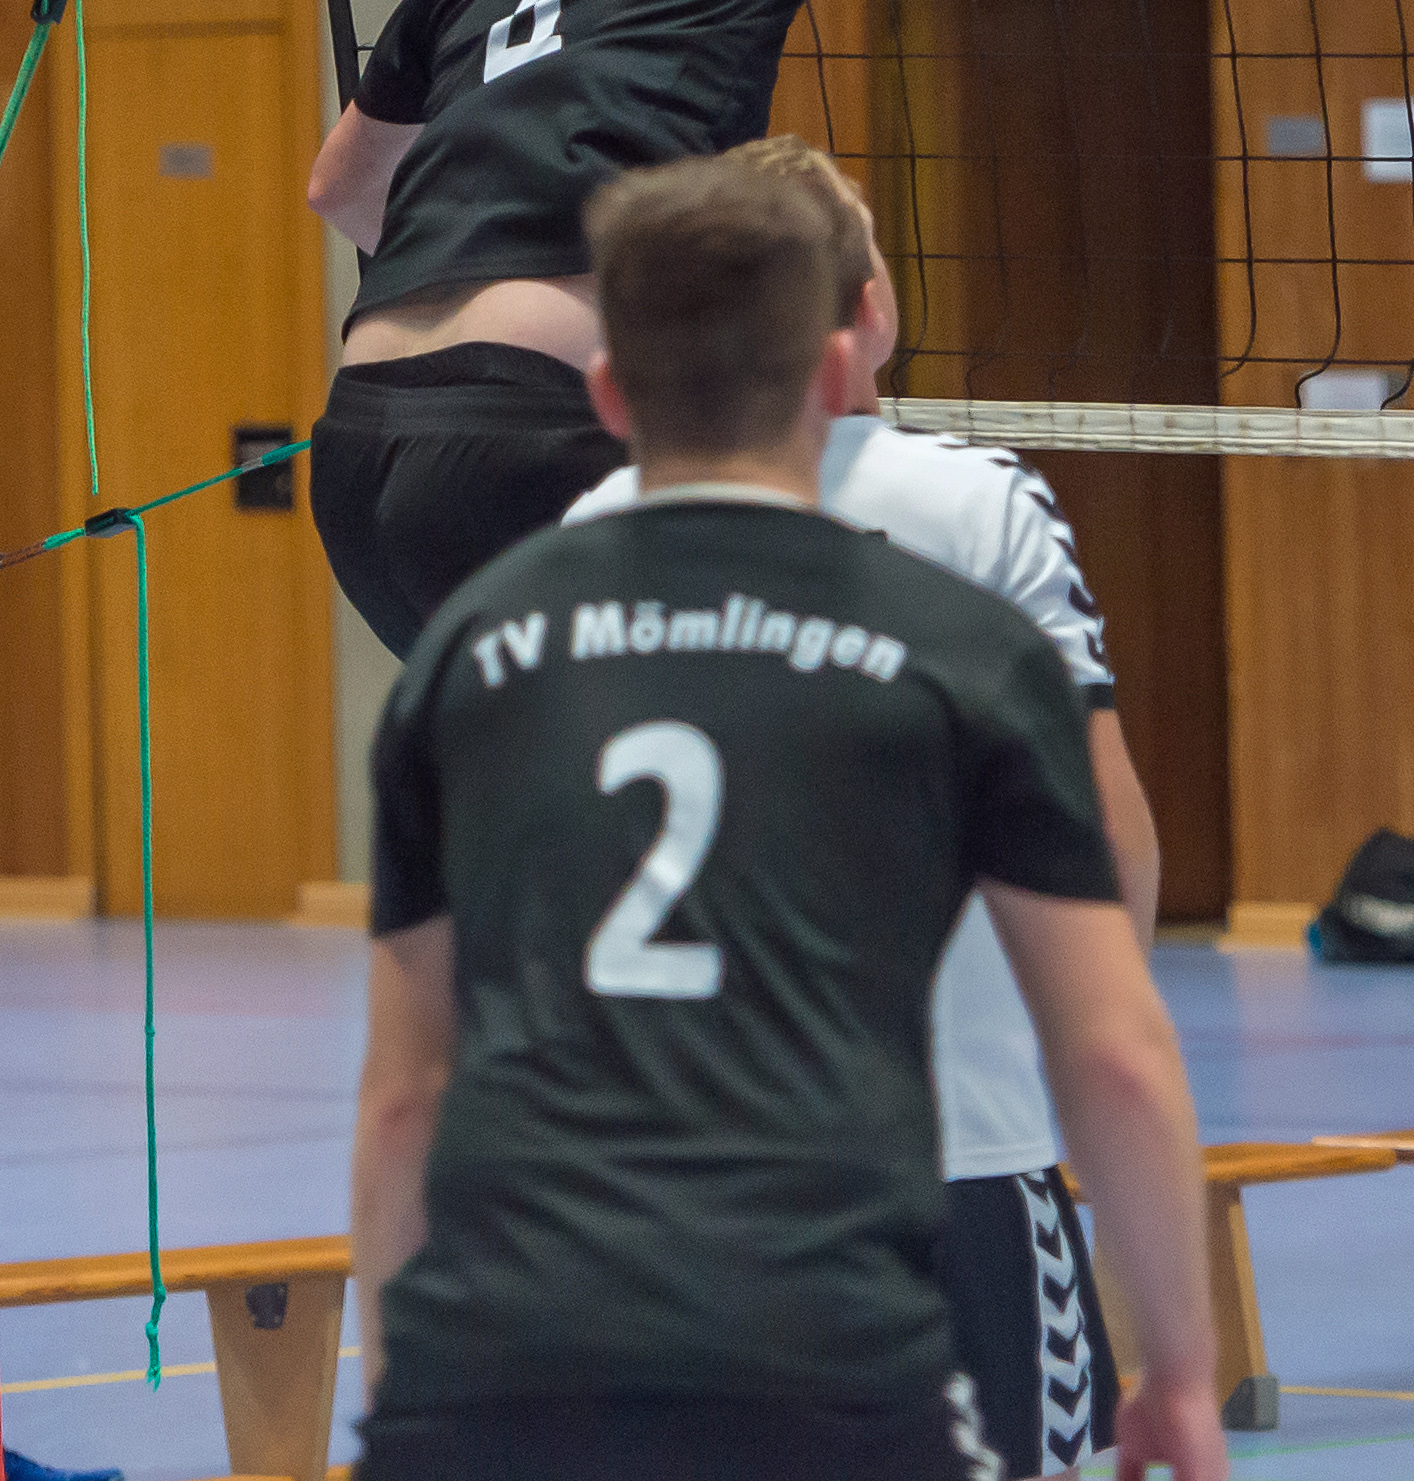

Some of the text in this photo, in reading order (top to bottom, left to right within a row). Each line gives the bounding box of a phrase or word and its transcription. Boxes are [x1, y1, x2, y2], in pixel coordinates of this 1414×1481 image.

[473, 592, 907, 688] TV Mömlingen
[586, 719, 725, 999] 2
